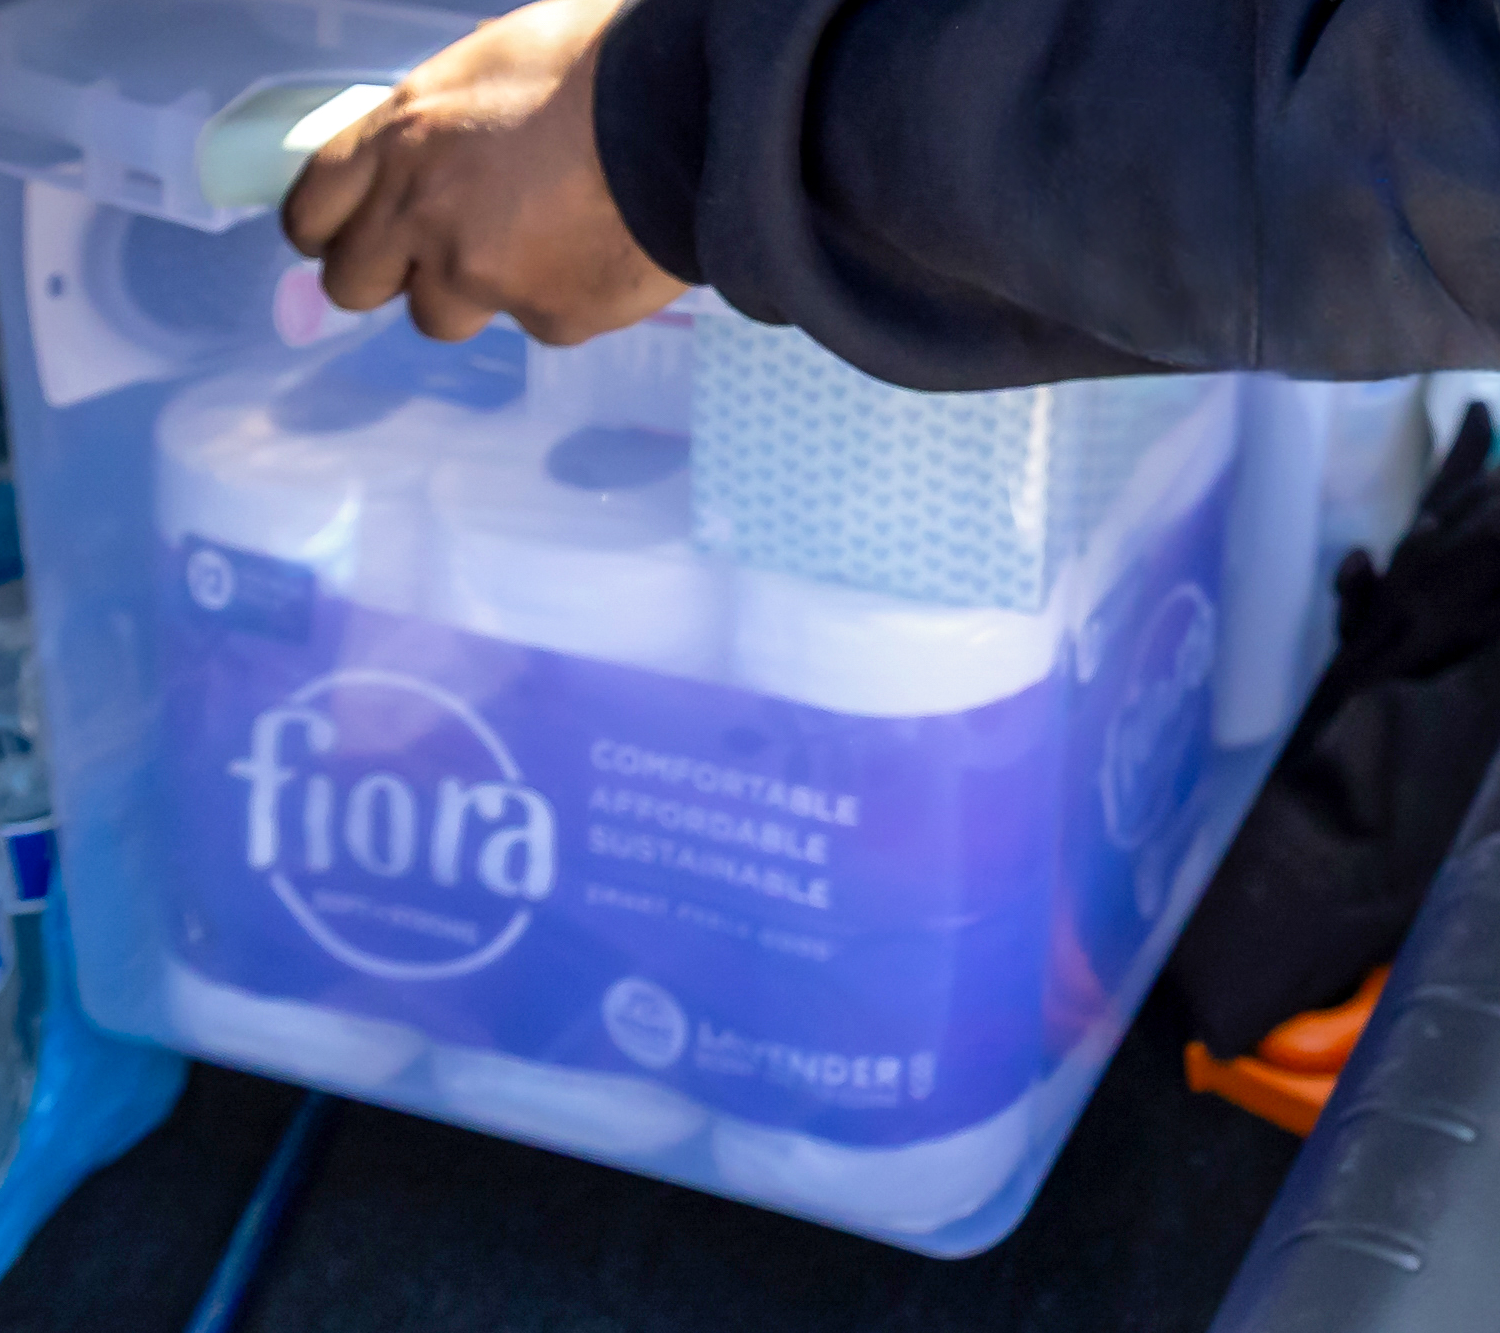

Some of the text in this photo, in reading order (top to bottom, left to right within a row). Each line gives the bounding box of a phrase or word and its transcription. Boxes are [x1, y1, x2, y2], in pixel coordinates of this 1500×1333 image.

[228, 705, 558, 901] fiora
[590, 738, 859, 826] COMFORTABLE
[587, 824, 831, 909] SUSTAINABLE
[588, 786, 828, 865] AFFORDABLE
